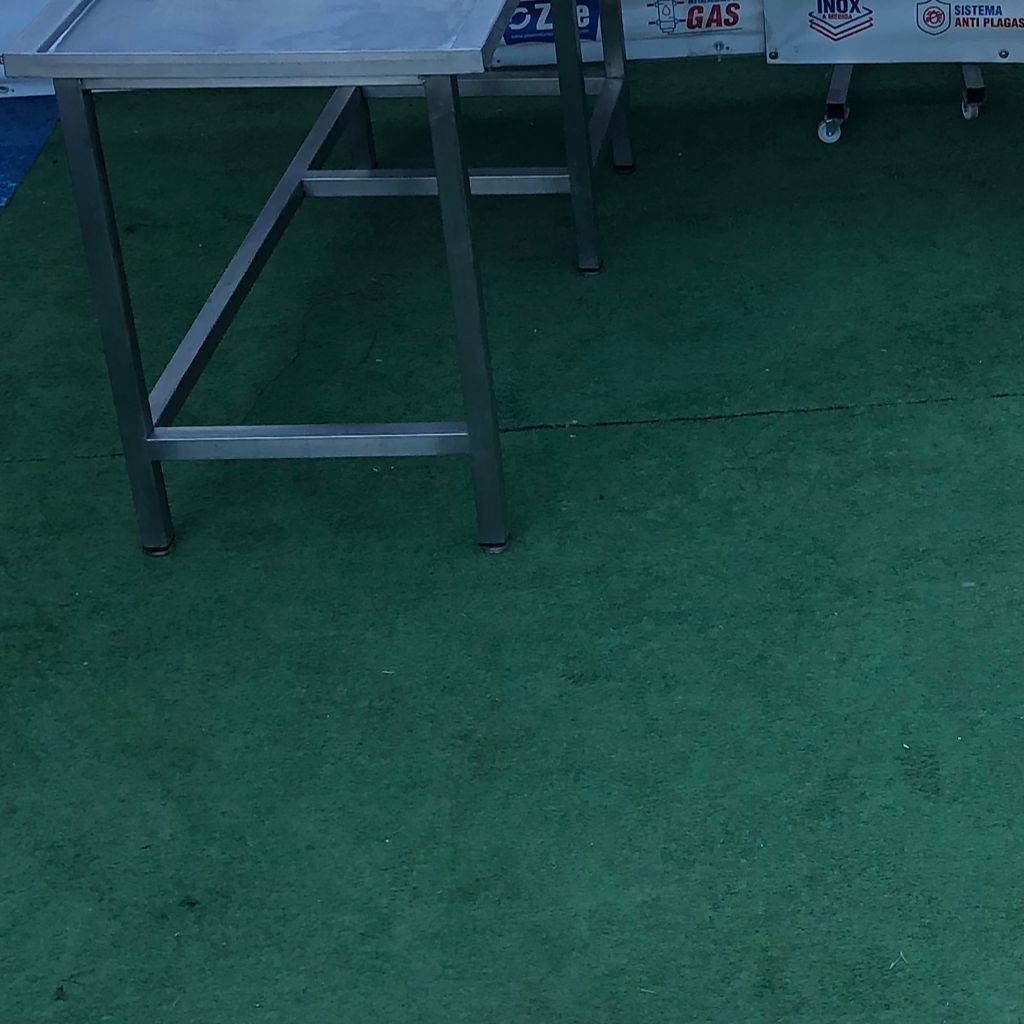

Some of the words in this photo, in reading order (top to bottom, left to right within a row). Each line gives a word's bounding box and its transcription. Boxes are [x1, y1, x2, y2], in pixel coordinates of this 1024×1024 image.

[954, 5, 1002, 16] SISTEMA
[686, 3, 741, 30] GAS
[954, 17, 979, 28] ANTI
[983, 17, 1024, 28] PLAGAS
